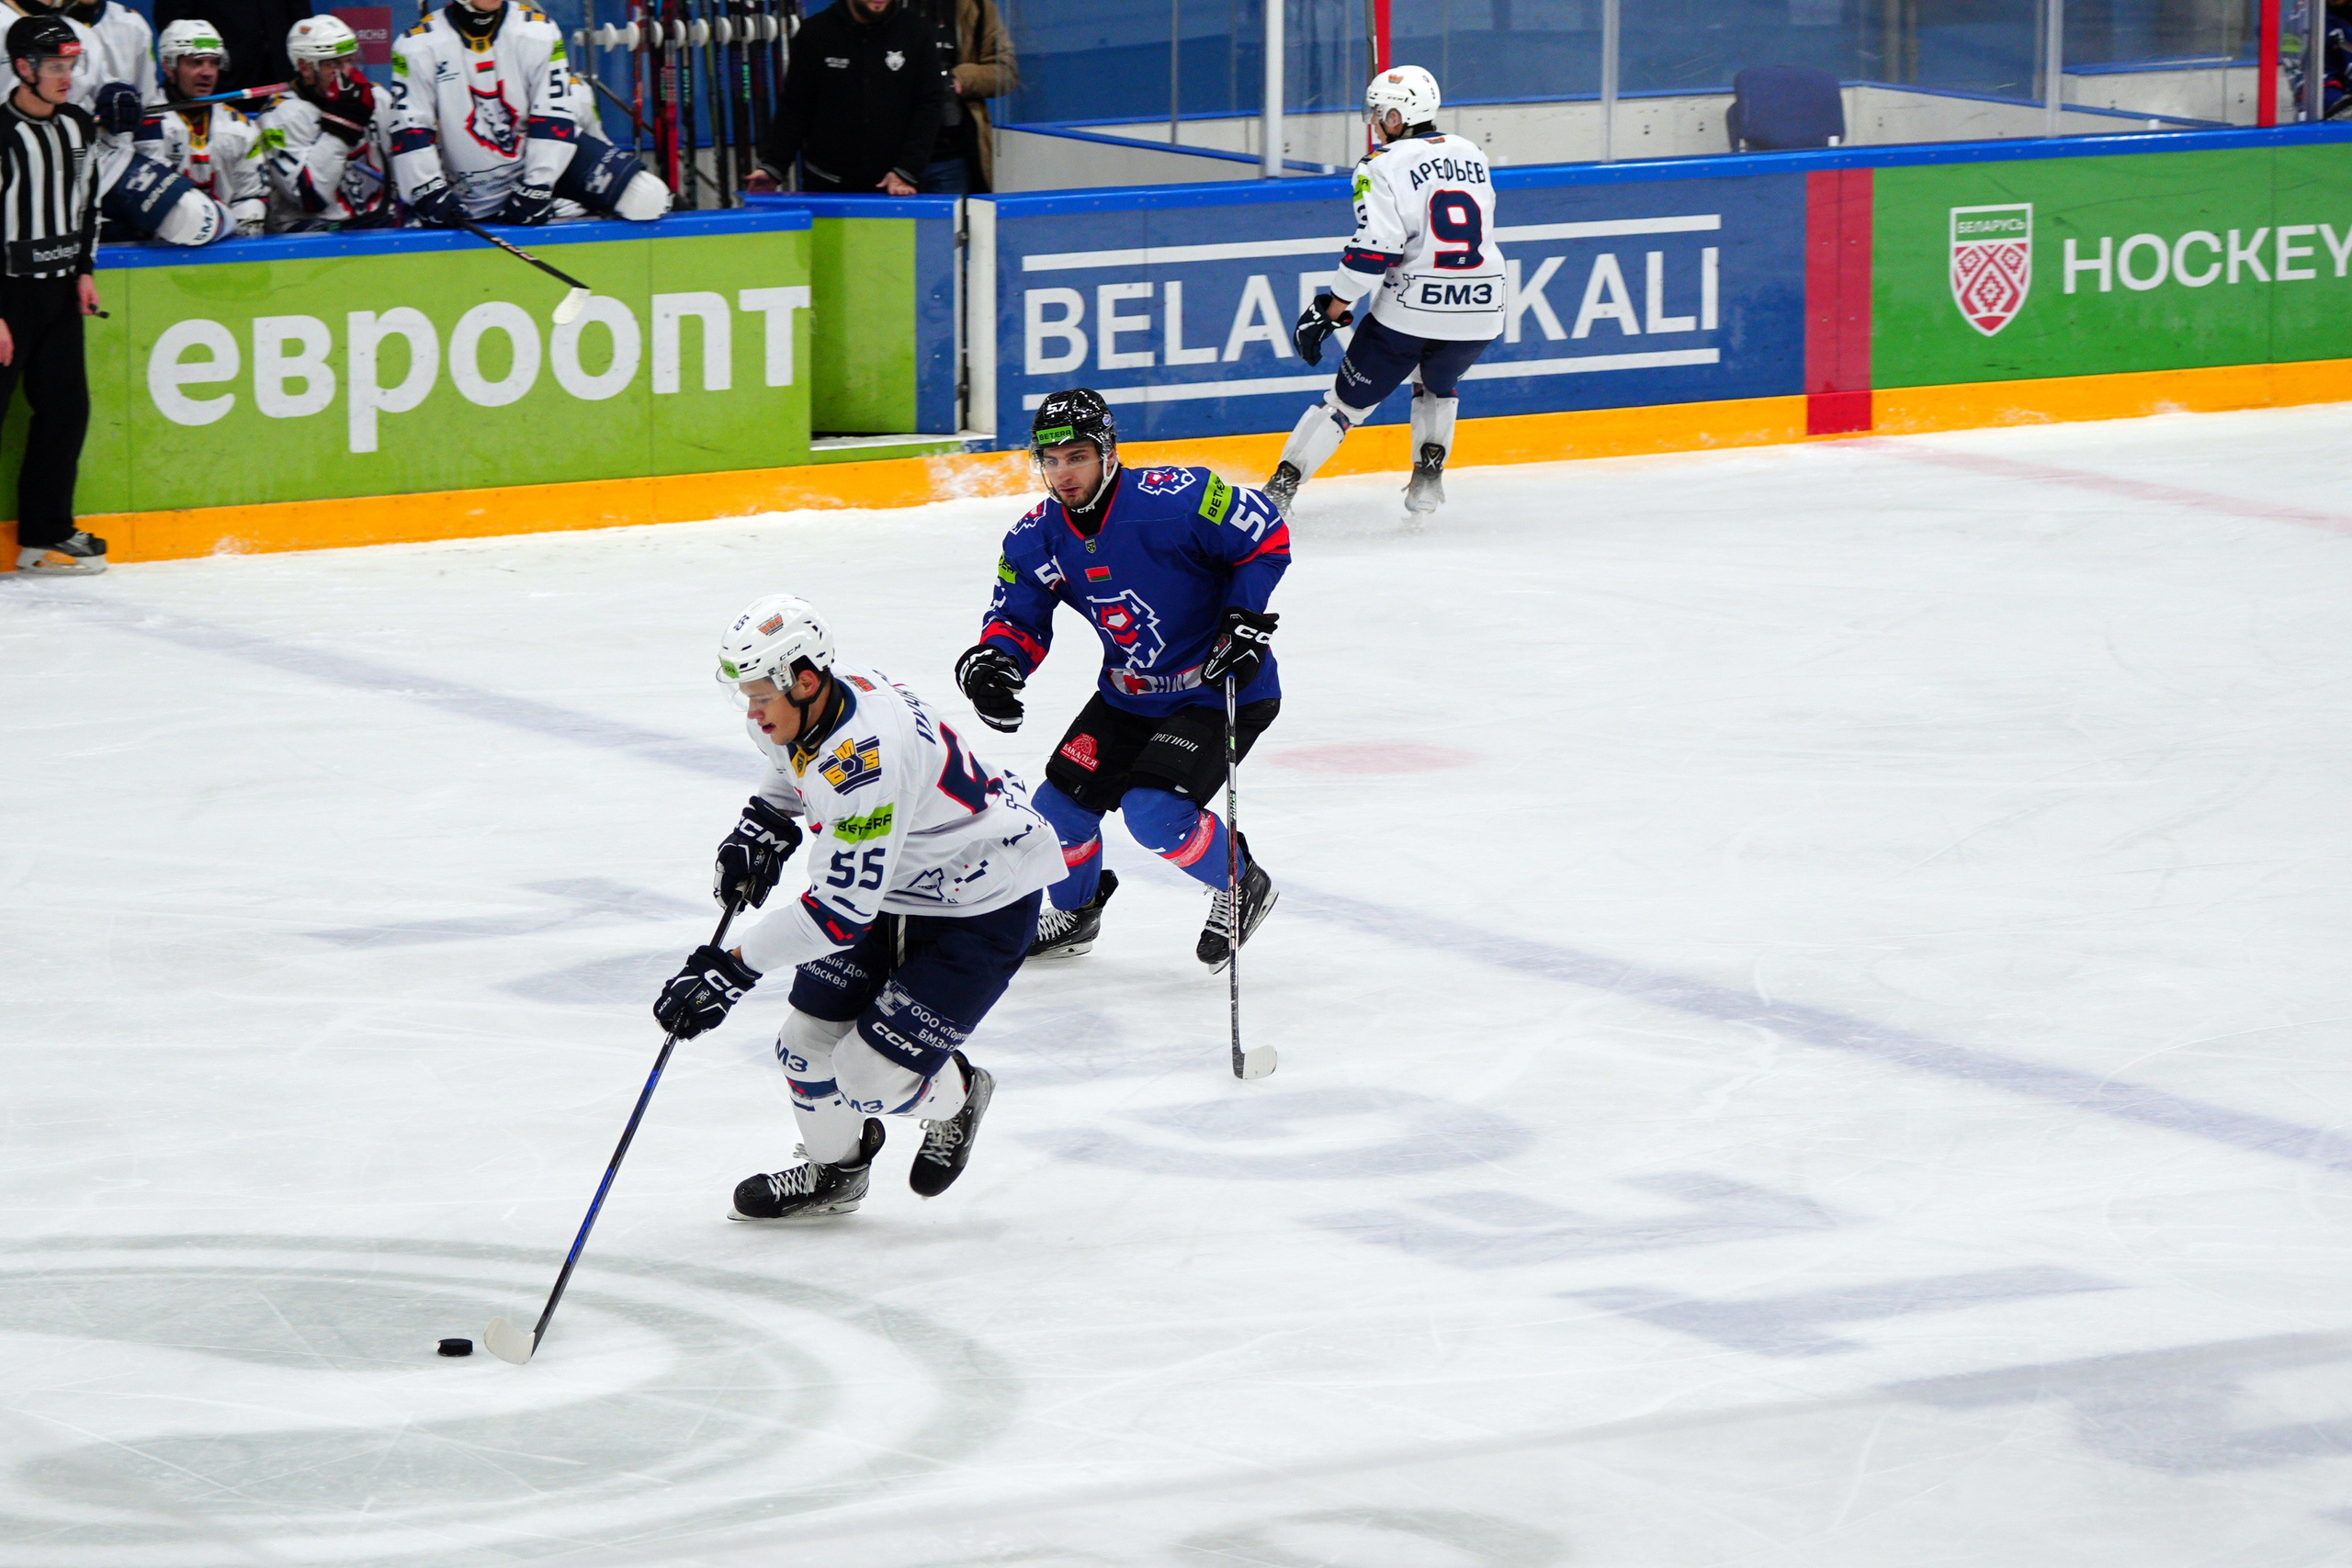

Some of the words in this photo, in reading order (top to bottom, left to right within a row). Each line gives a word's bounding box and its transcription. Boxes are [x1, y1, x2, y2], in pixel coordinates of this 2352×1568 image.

[1409, 157, 1486, 191] АРЕФЬЕВ
[1429, 189, 1485, 269] 9
[1958, 218, 2026, 234] БЕЛАРУСЬ
[2064, 223, 2352, 294] HOCKEY
[1023, 245, 1719, 376] BELARKALI
[1420, 282, 1493, 305] БМЗ
[147, 285, 811, 453] евроопт
[1046, 400, 1069, 415] 57
[1229, 486, 1270, 543] 57
[779, 643, 801, 661] CCM
[1234, 625, 1273, 645] CC
[1062, 743, 1098, 768] БАКАЛЕЯ
[826, 847, 887, 891] 55
[704, 969, 747, 1001] CC
[910, 1005, 940, 1028] ООО
[775, 1036, 808, 1073] МЗ
[871, 1021, 923, 1057] CCM
